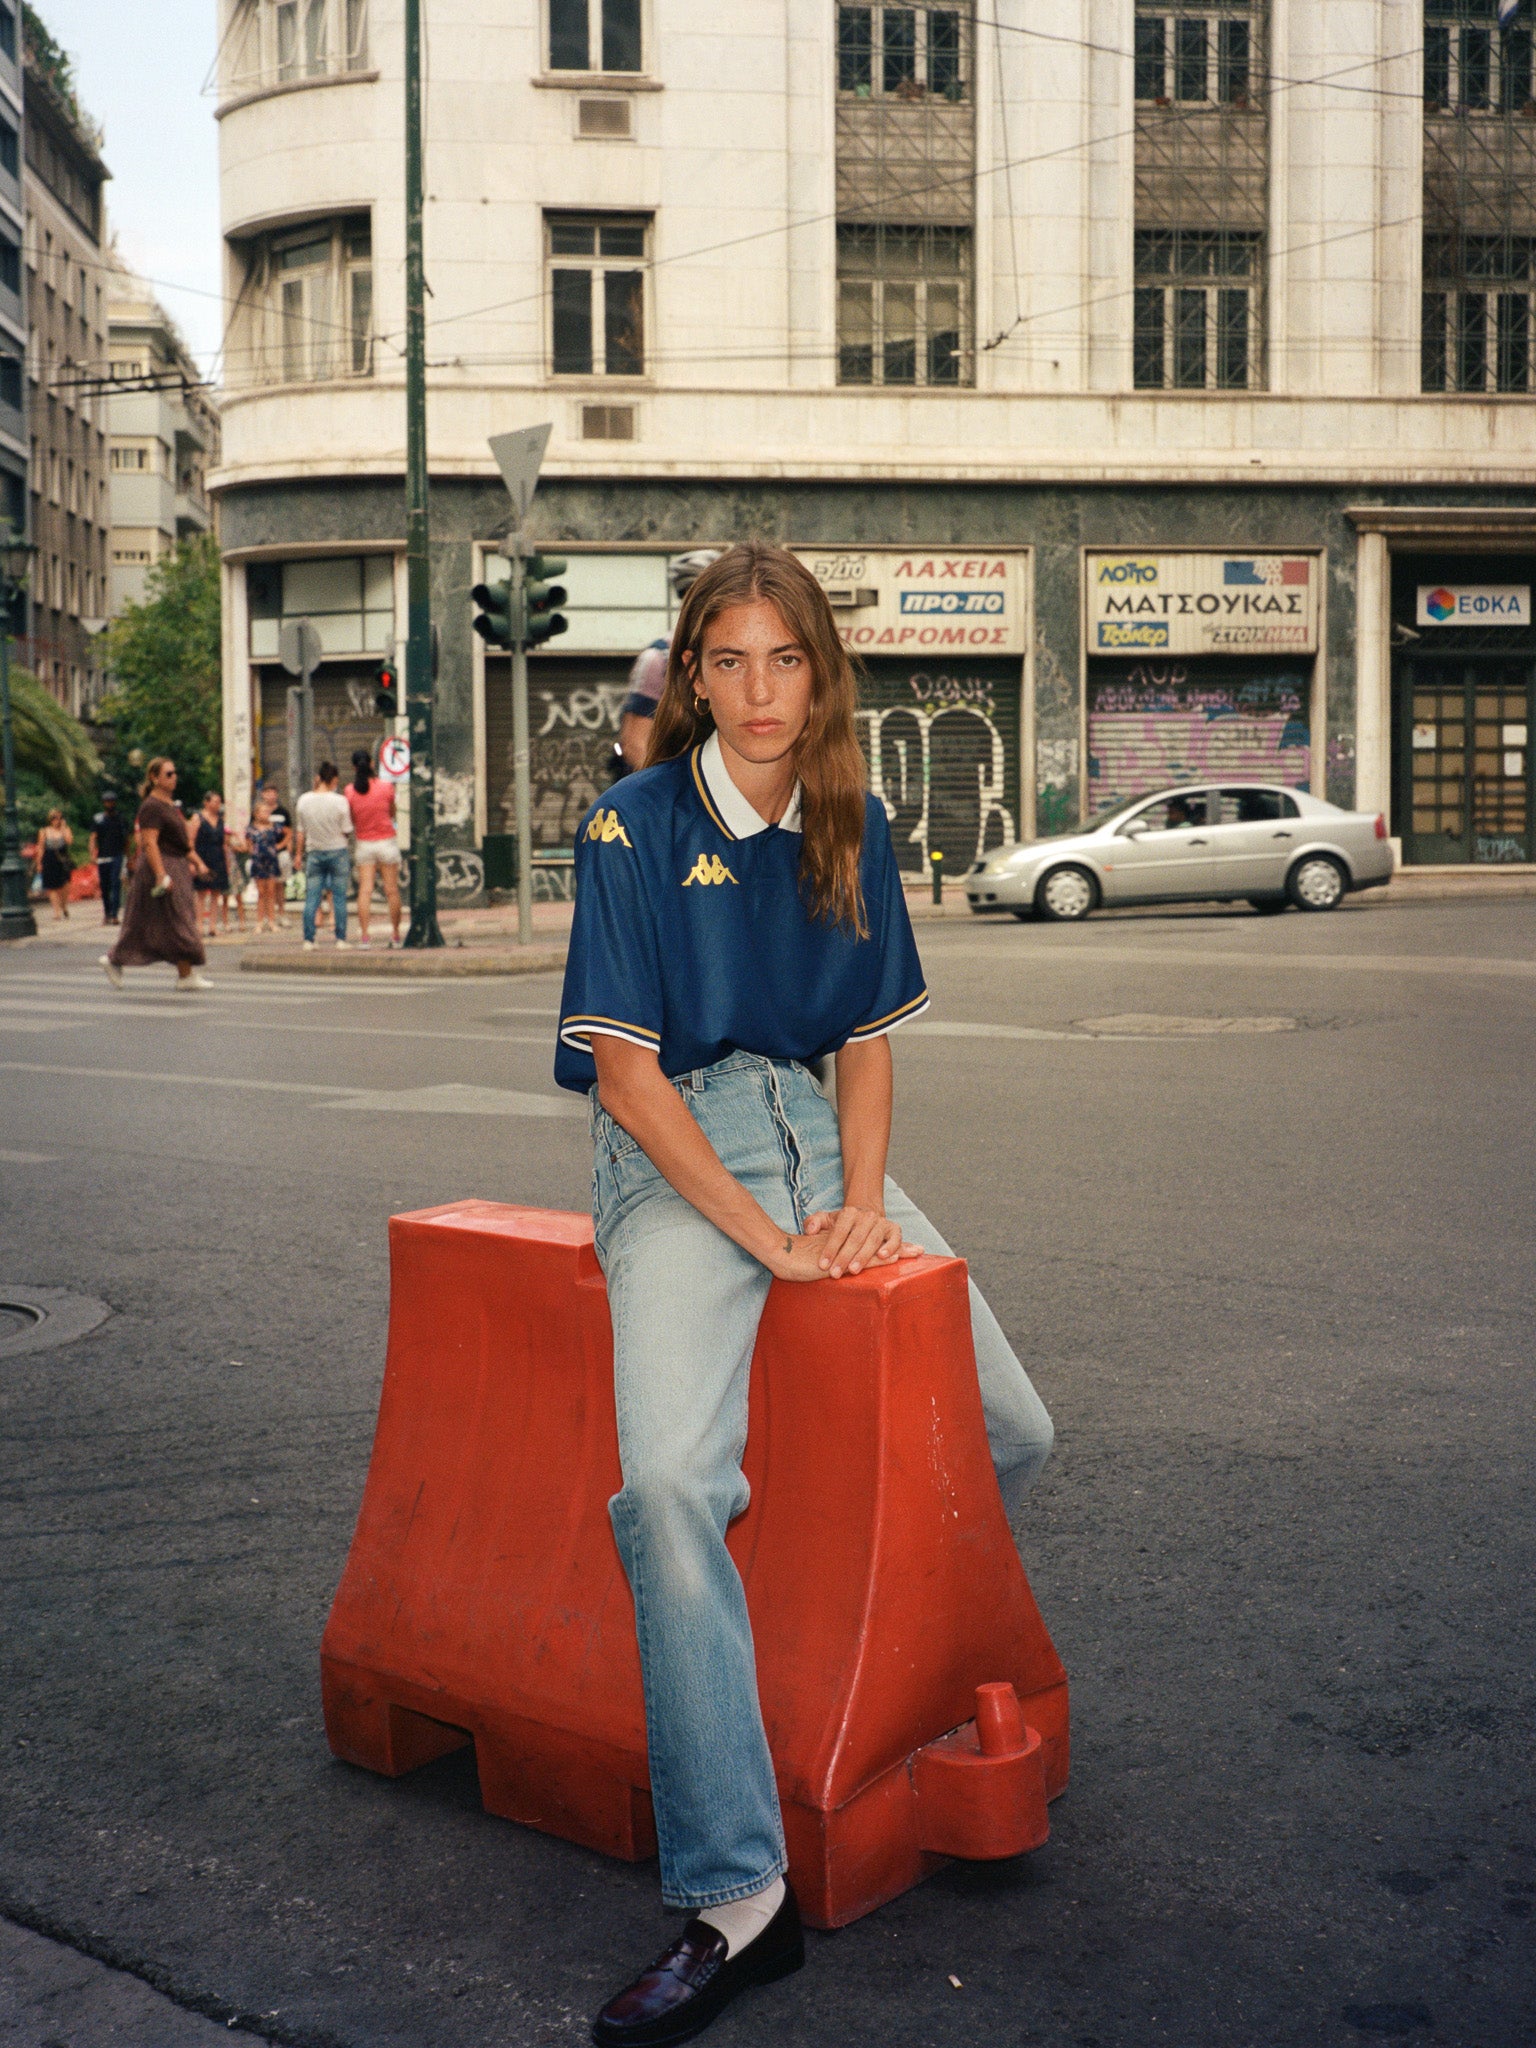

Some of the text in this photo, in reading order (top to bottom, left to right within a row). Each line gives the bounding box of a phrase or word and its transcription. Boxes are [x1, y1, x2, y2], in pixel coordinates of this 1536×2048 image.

[894, 560, 1008, 578] ΛΑΧΕΙΑ
[1105, 594, 1302, 615] ΜΑΤΣΟΥΚΑΣ
[1458, 595, 1521, 614] ΕΦΚΑ
[838, 627, 1009, 645] ΠΟΔΡΟΜΟΣ
